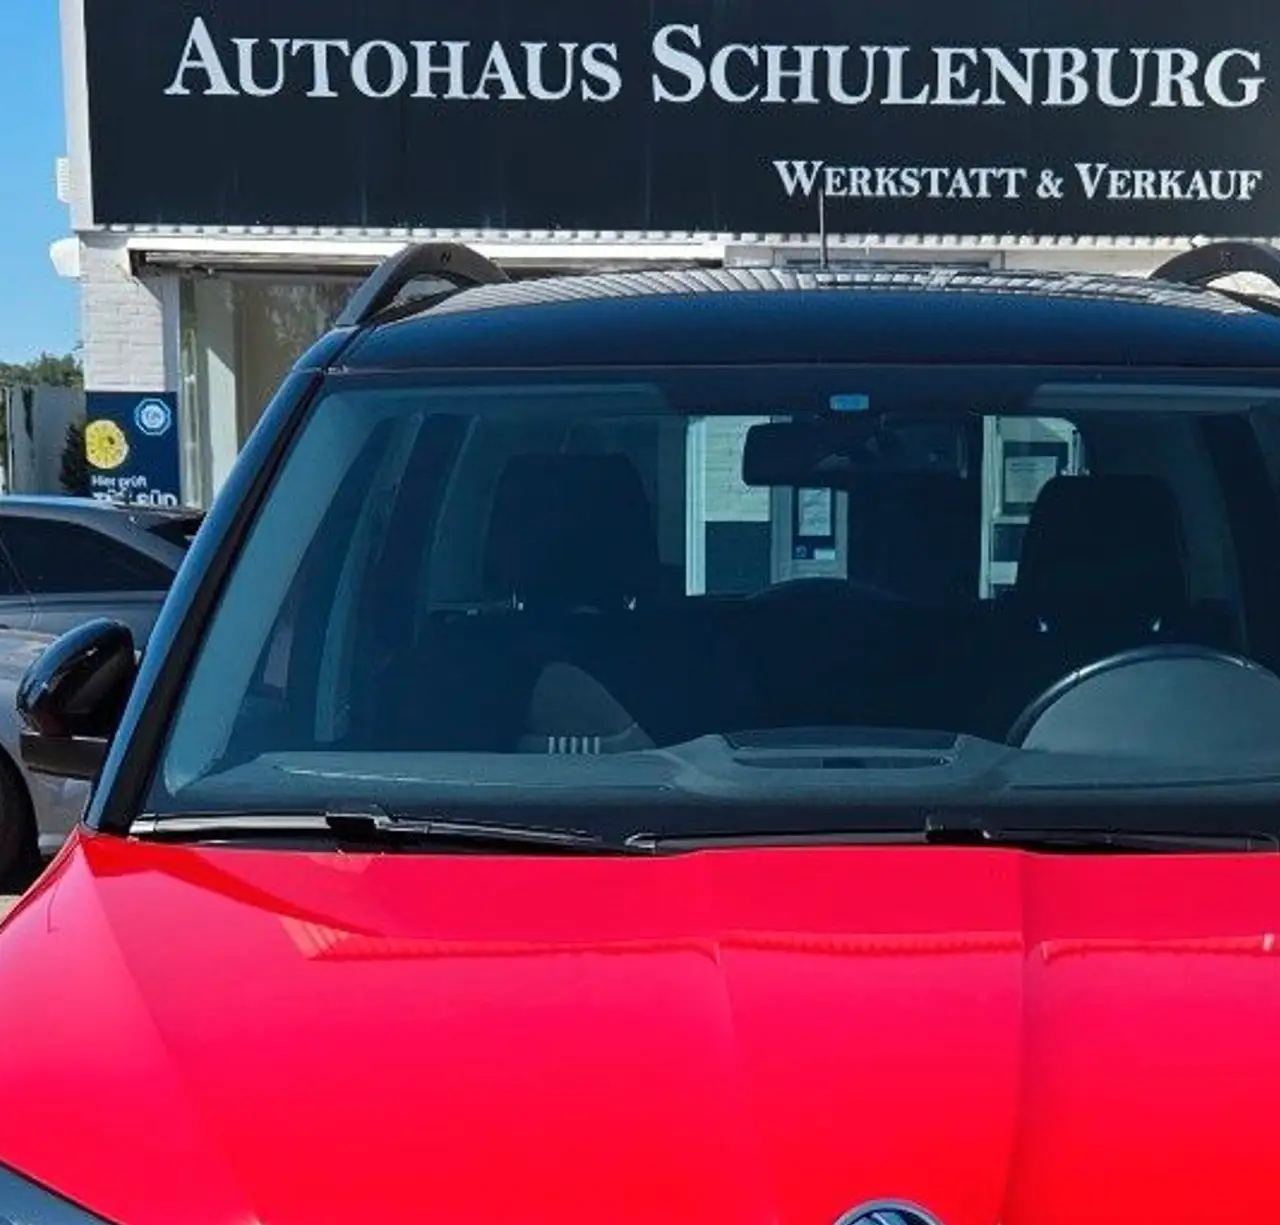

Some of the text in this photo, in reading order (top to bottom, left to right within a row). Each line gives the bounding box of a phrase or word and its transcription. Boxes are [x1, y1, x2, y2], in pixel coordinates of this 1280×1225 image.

[165, 17, 1265, 107] AUTOHAUS SCHULENBURG
[772, 160, 1262, 200] WERKSTATT & VERKAUF
